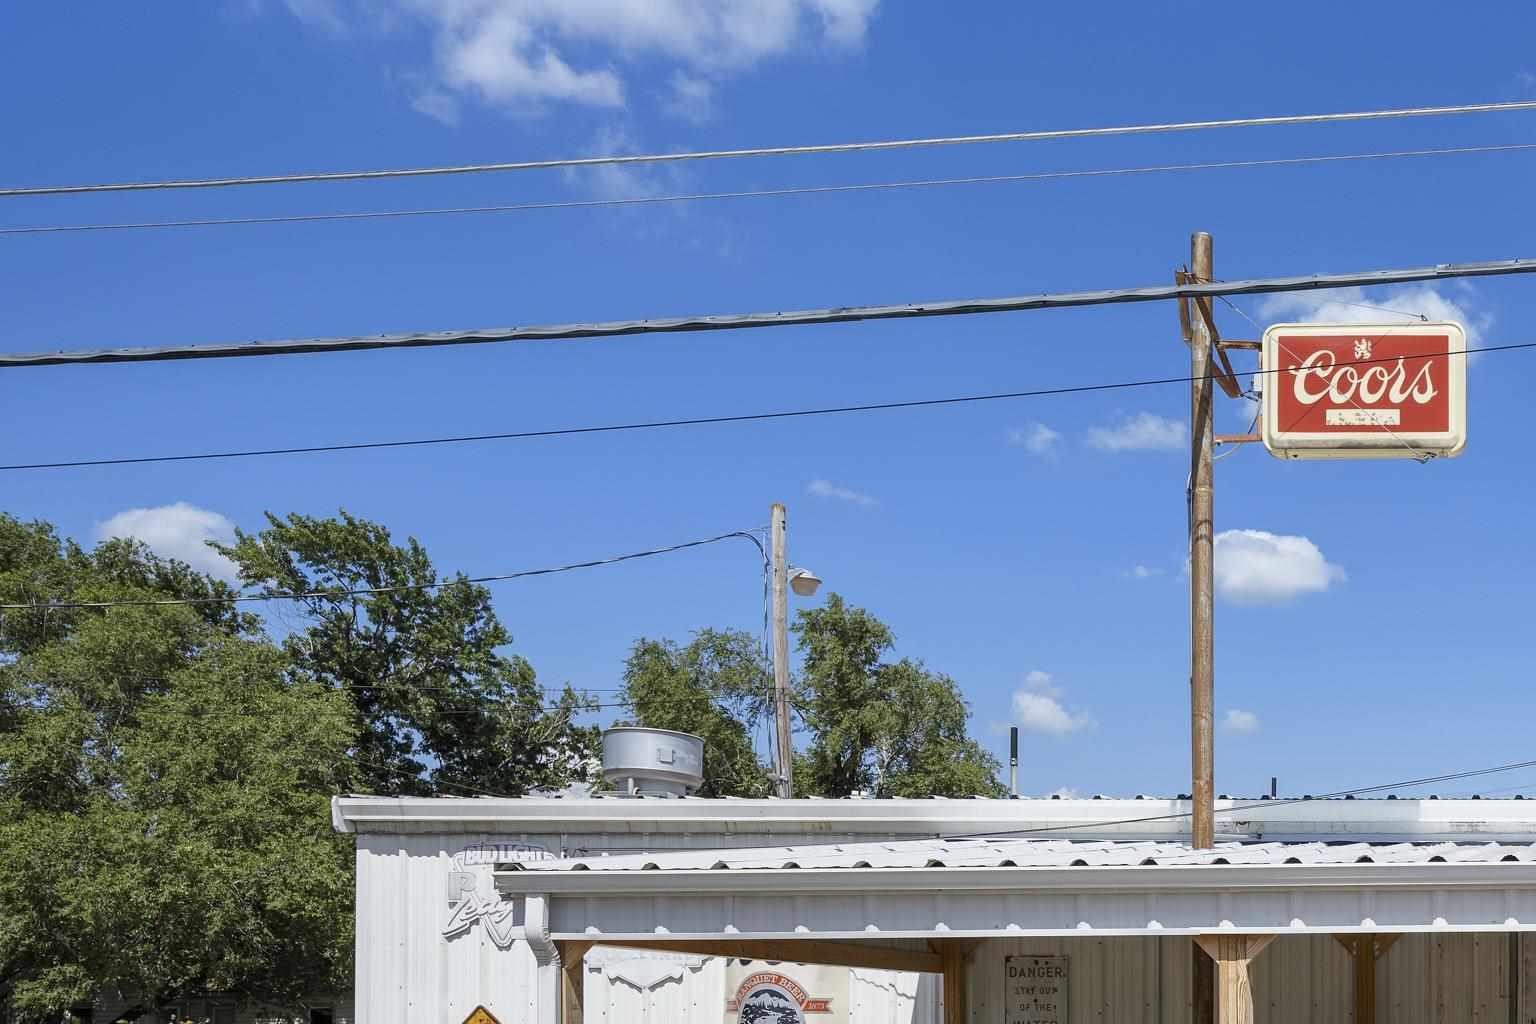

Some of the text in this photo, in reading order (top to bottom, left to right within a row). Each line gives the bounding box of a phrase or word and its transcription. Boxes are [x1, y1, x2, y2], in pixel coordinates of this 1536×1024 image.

[1288, 350, 1438, 405] Coors
[1008, 966, 1065, 978] DANGER
[779, 976, 806, 1001] BEER
